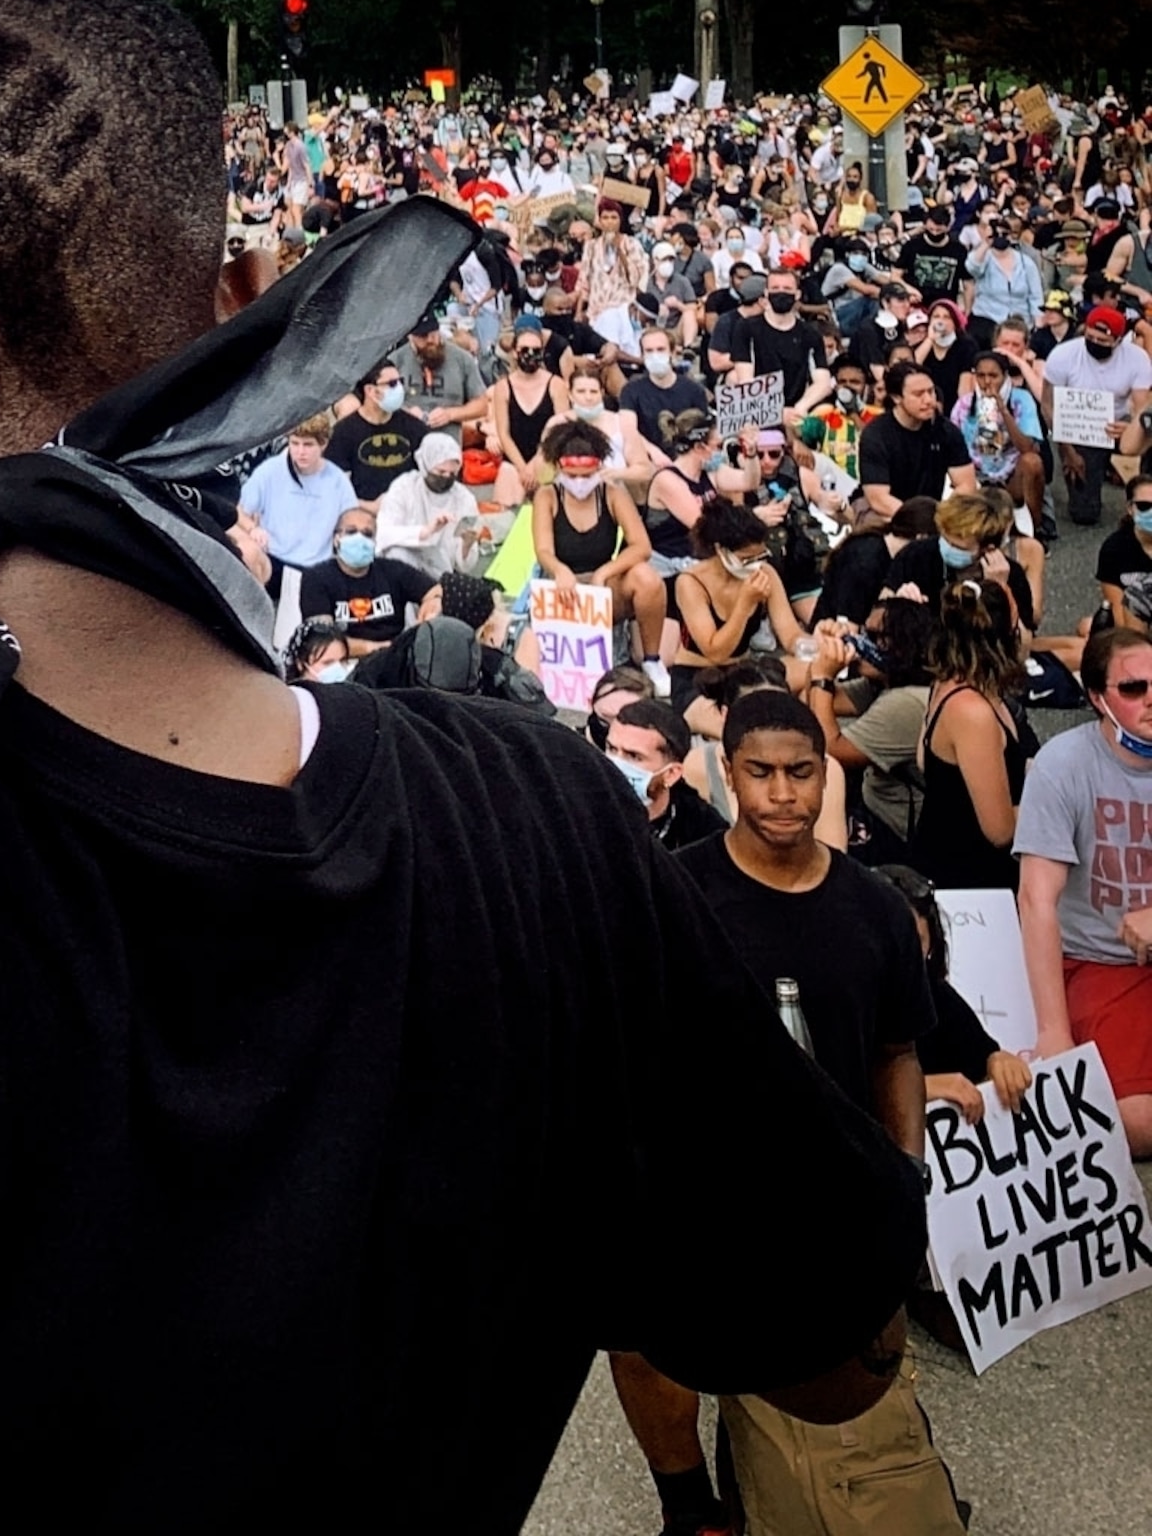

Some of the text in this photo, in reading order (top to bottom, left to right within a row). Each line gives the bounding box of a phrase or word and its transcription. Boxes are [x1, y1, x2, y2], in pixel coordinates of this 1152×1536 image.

[720, 375, 778, 404] STOP
[1066, 390, 1103, 404] STOP
[719, 396, 767, 417] KILLING
[720, 409, 779, 434] FRIENDS
[927, 1059, 1115, 1194] BLACK
[976, 1141, 1119, 1250] LIVES
[957, 1204, 1152, 1351] MATTER
